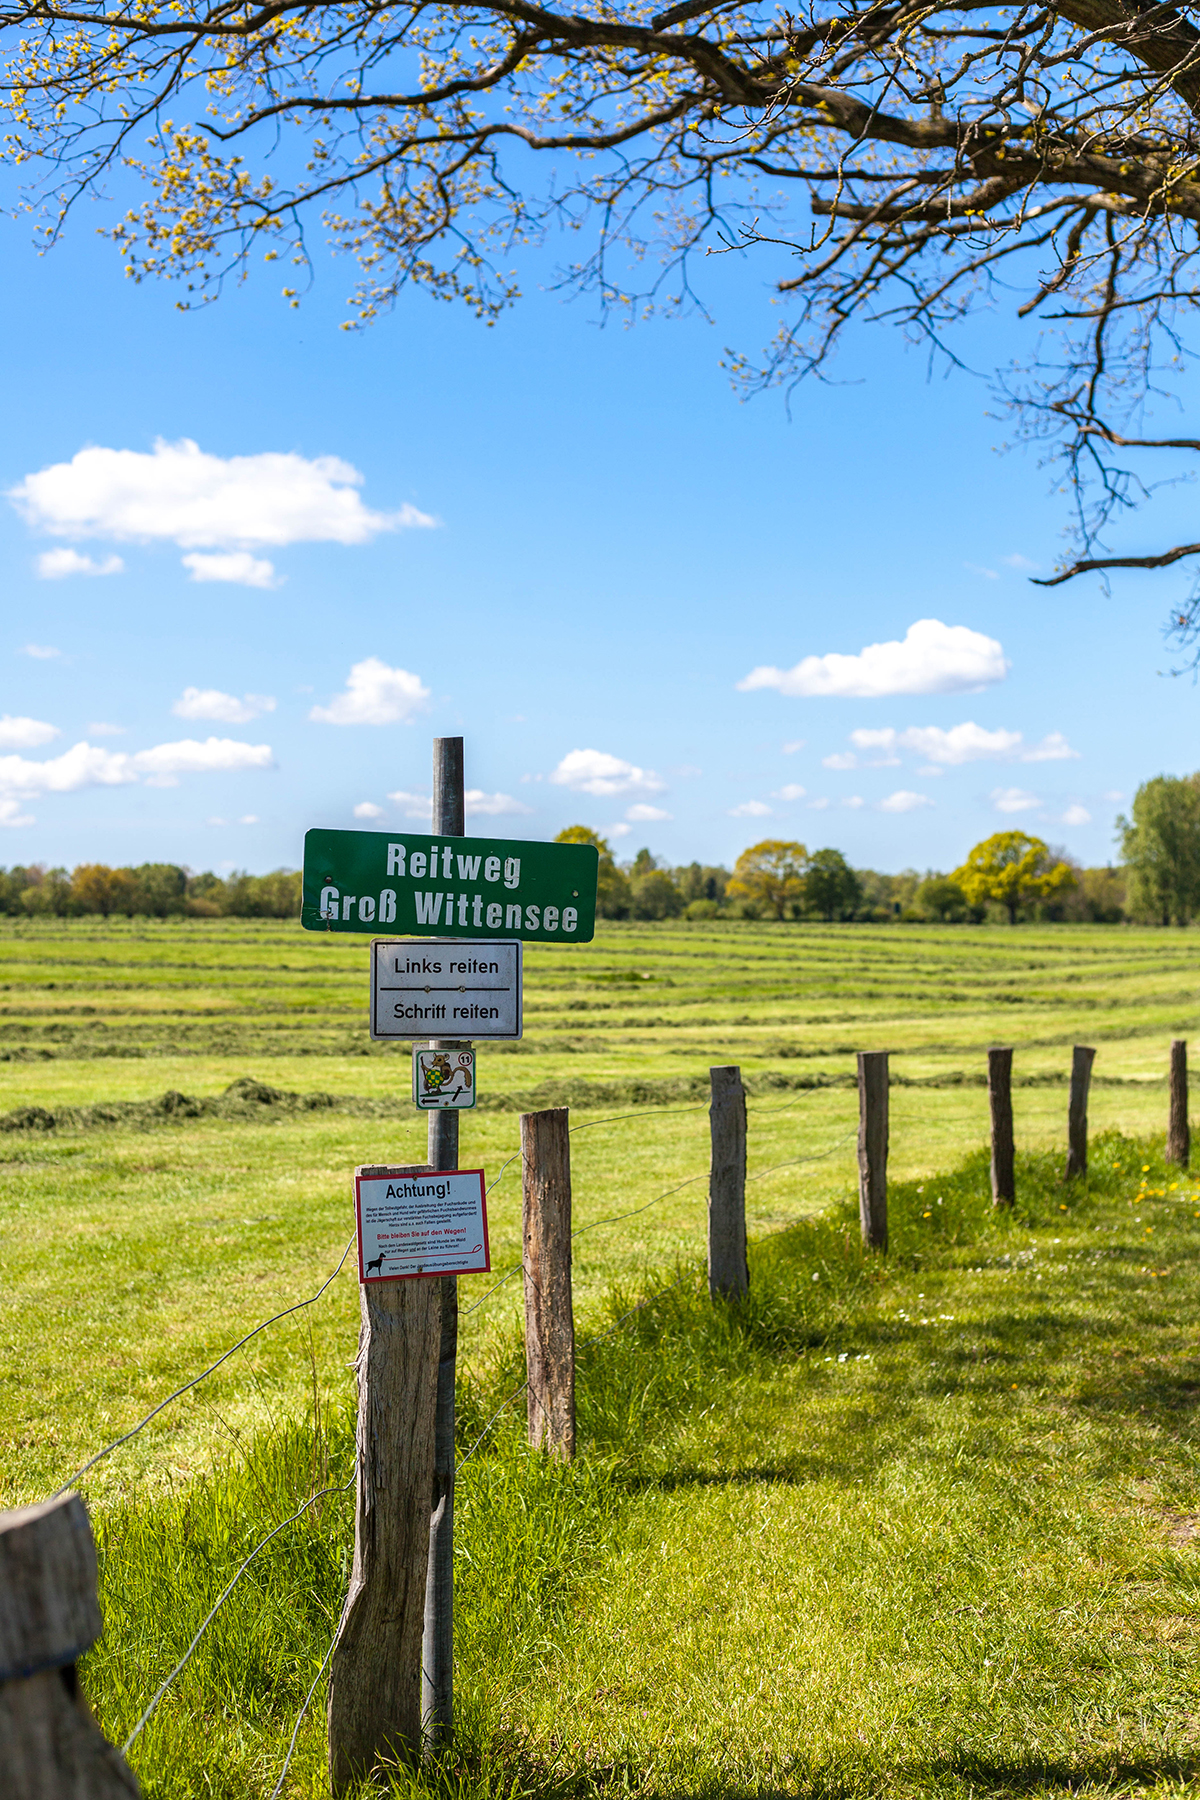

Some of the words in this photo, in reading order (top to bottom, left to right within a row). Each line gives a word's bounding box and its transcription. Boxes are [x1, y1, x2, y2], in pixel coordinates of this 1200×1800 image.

[386, 843, 521, 889] Reitweg
[319, 886, 397, 923] Groß
[414, 891, 578, 932] Wittensee
[394, 958, 442, 974] Links
[450, 958, 499, 974] reiten
[393, 1003, 446, 1019] Schritt
[453, 1003, 499, 1019] reiten
[460, 1055, 470, 1064] 11
[386, 1181, 451, 1199] Achtung!
[390, 1231, 411, 1239] bleiben
[443, 1227, 467, 1235] Wegen!
